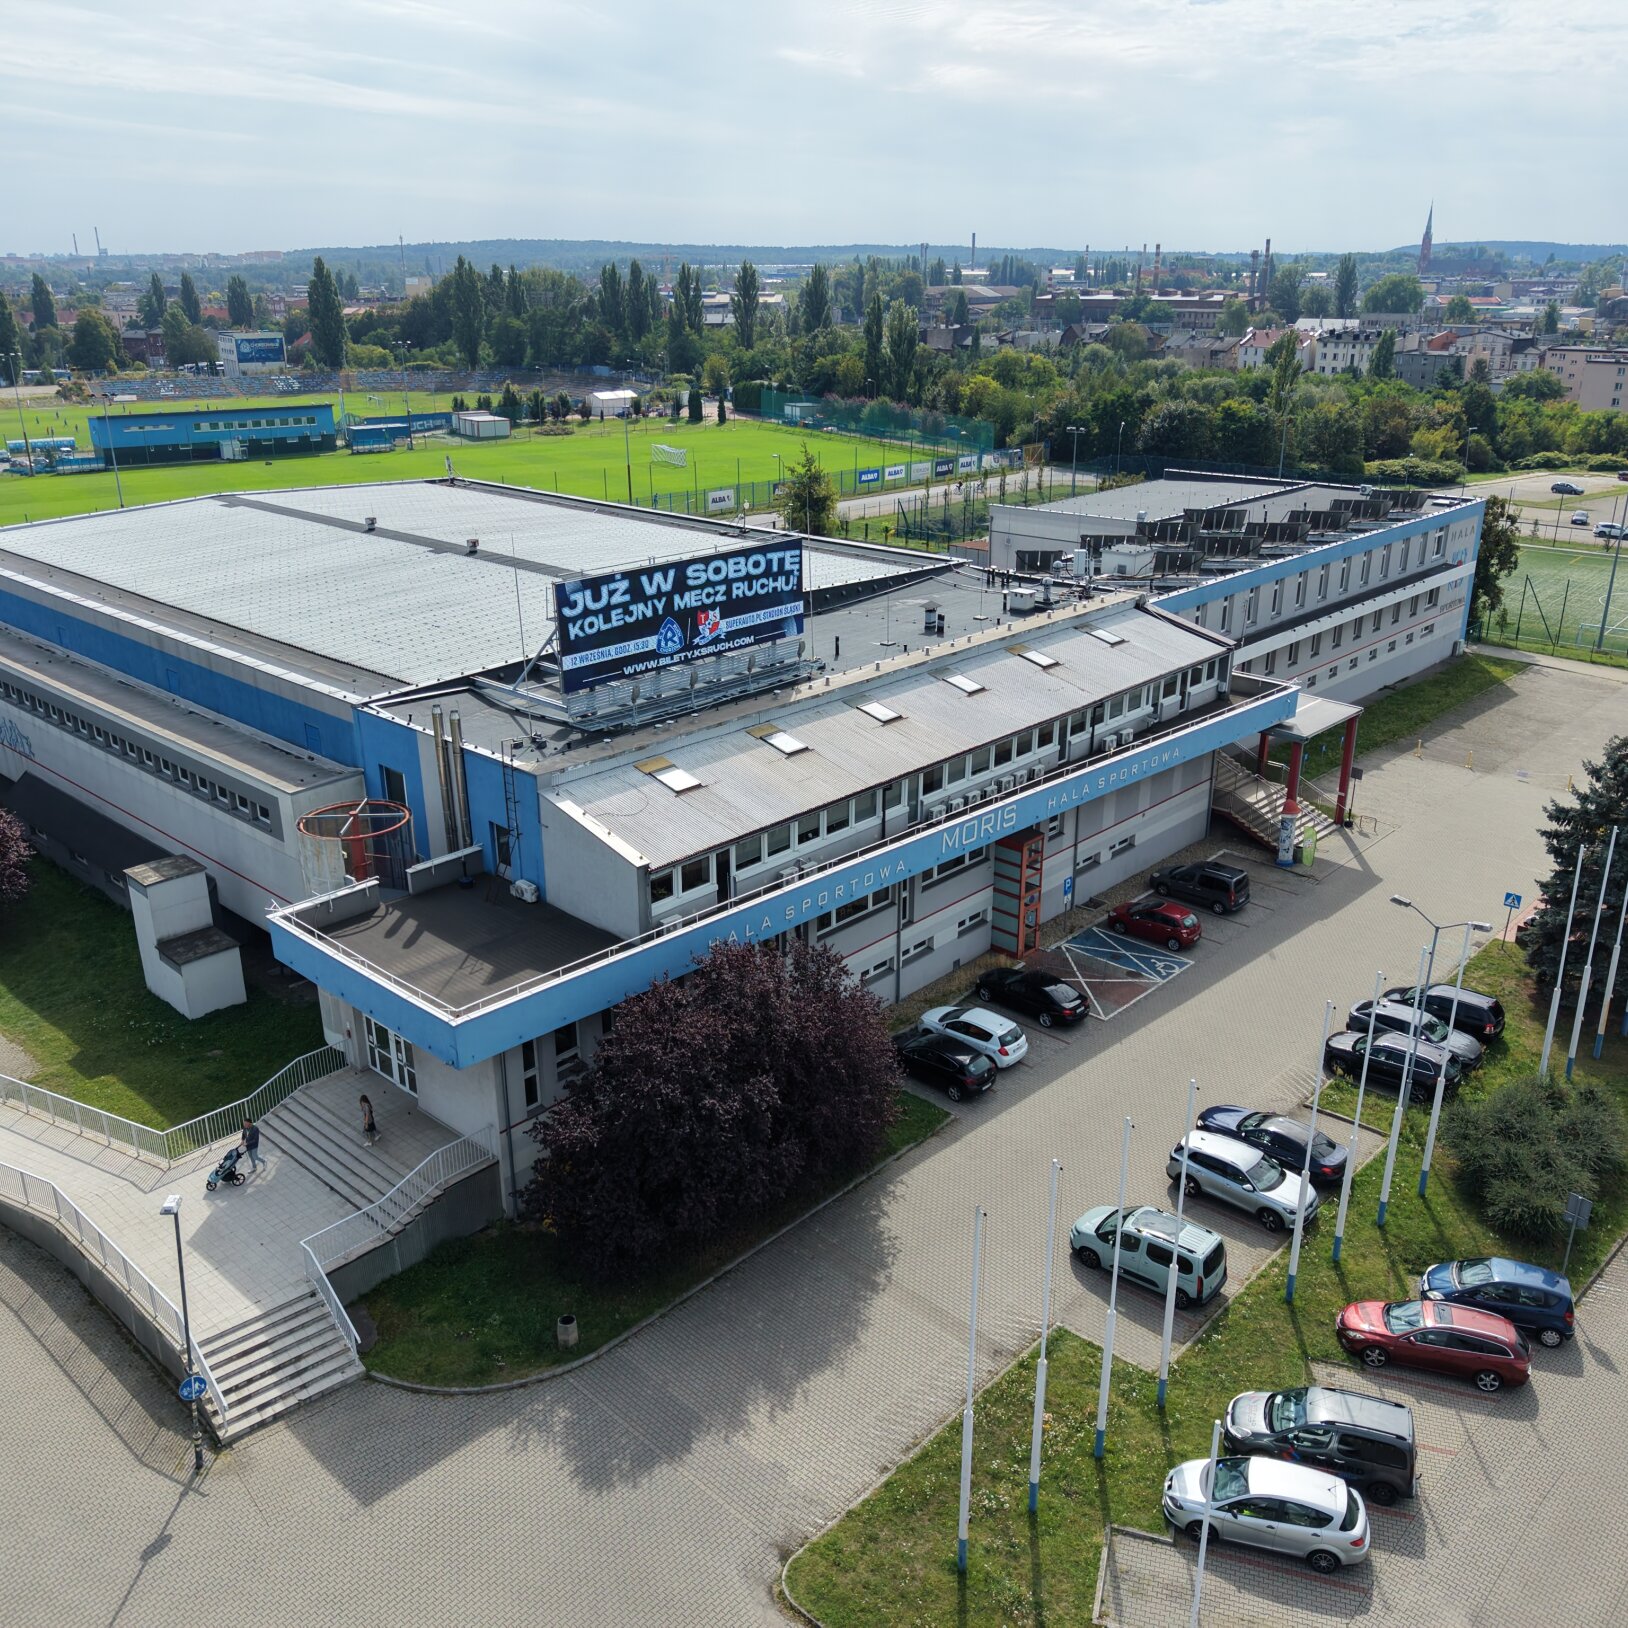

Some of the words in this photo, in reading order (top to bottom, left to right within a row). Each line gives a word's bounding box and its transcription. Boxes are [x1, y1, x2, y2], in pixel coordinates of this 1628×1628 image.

[960, 461, 972, 469] ALBA
[861, 473, 875, 481] ALBA
[711, 495, 727, 504] ALBA
[1450, 526, 1475, 542] HALA
[561, 573, 631, 618] JUŻ
[640, 568, 676, 597] W
[685, 549, 801, 587] SOBOTĘ
[567, 596, 667, 641] KOLEJNY
[673, 584, 728, 612] MECZ
[731, 574, 798, 600] RUCHU!
[570, 656, 578, 666] 12
[623, 635, 755, 675] WWW.BILETY.KSRUCH.COM
[784, 859, 906, 920] SPORTOWA
[942, 804, 1018, 854] MORIS
[1047, 783, 1090, 810] HALA
[1097, 747, 1181, 789] SPORTOWA
